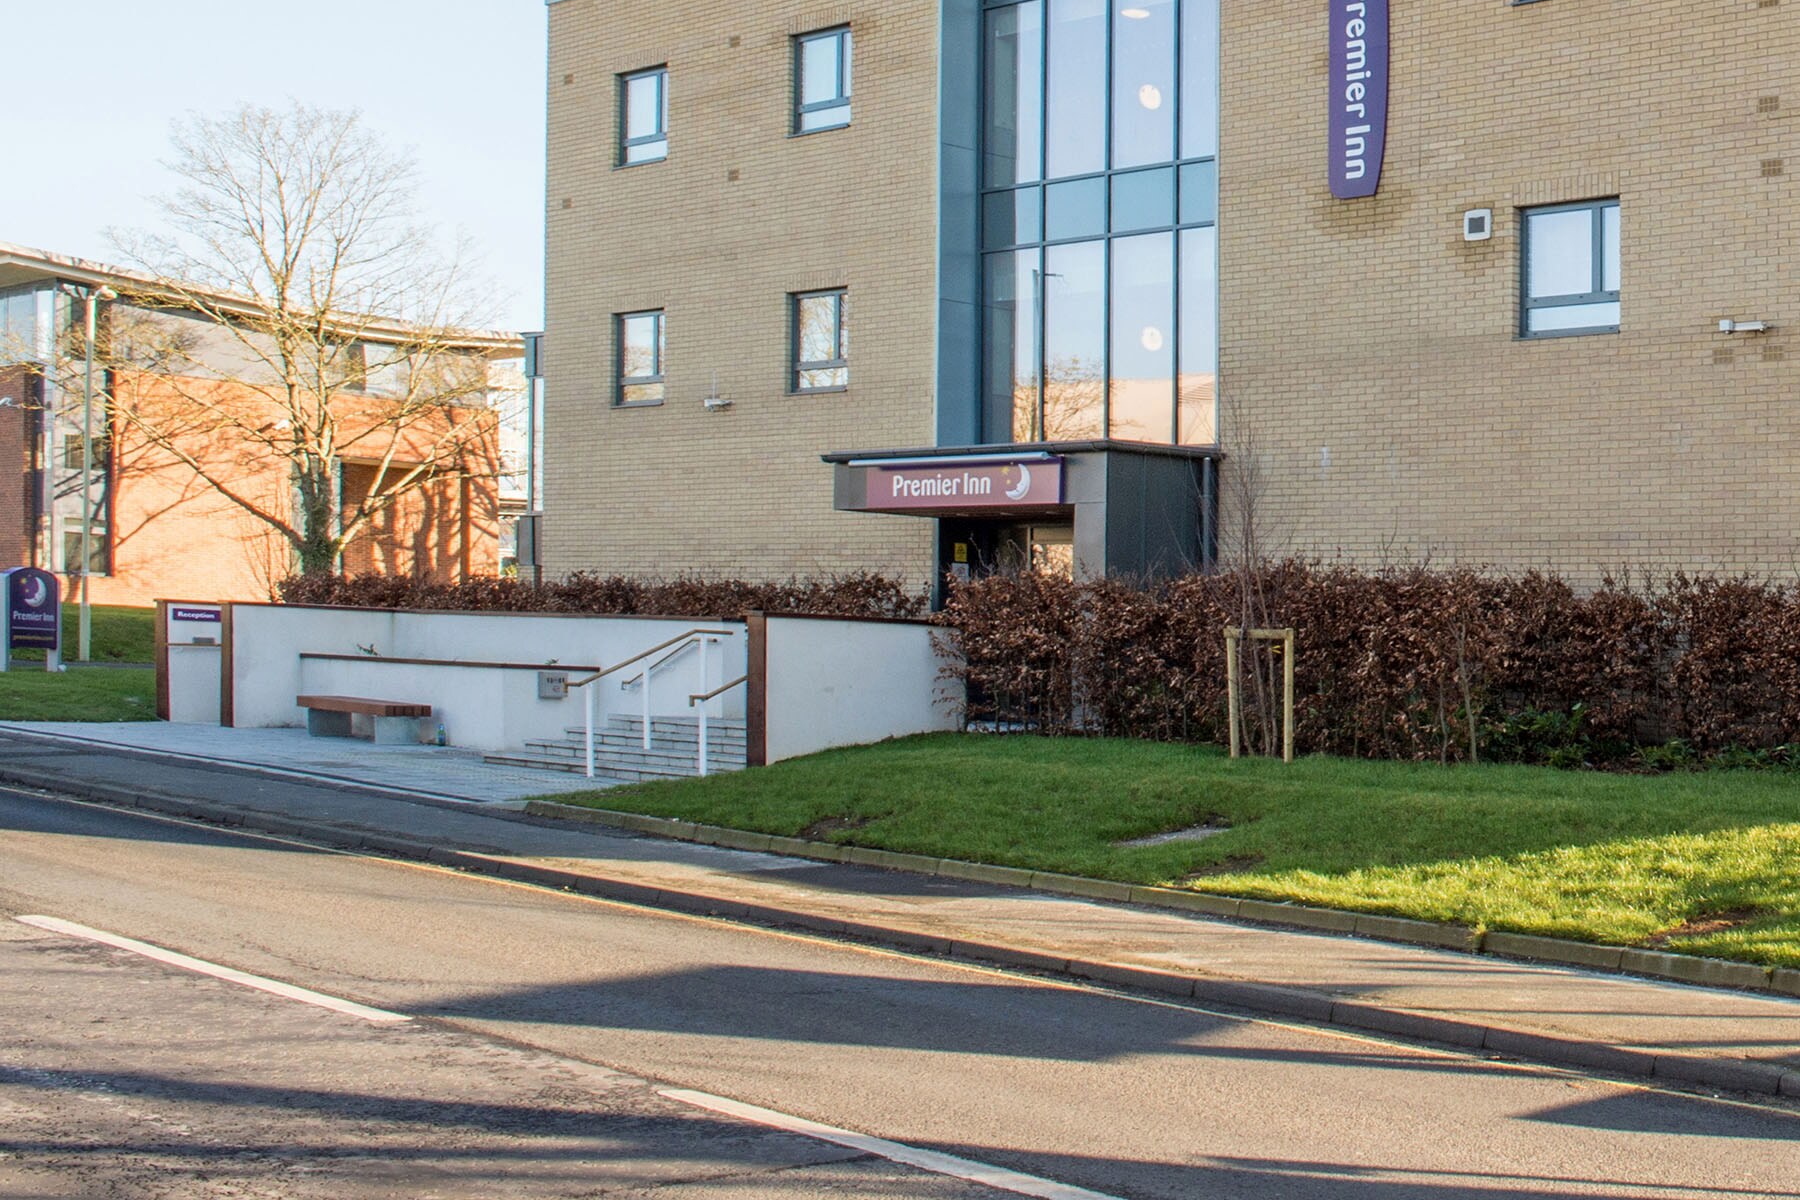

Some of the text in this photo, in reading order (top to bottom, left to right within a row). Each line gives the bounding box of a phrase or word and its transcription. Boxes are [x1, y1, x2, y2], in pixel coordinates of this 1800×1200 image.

[1345, 125, 1371, 180] Inn
[892, 472, 991, 497] Premier Inn
[13, 610, 42, 621] Premier
[177, 611, 216, 619] Reception
